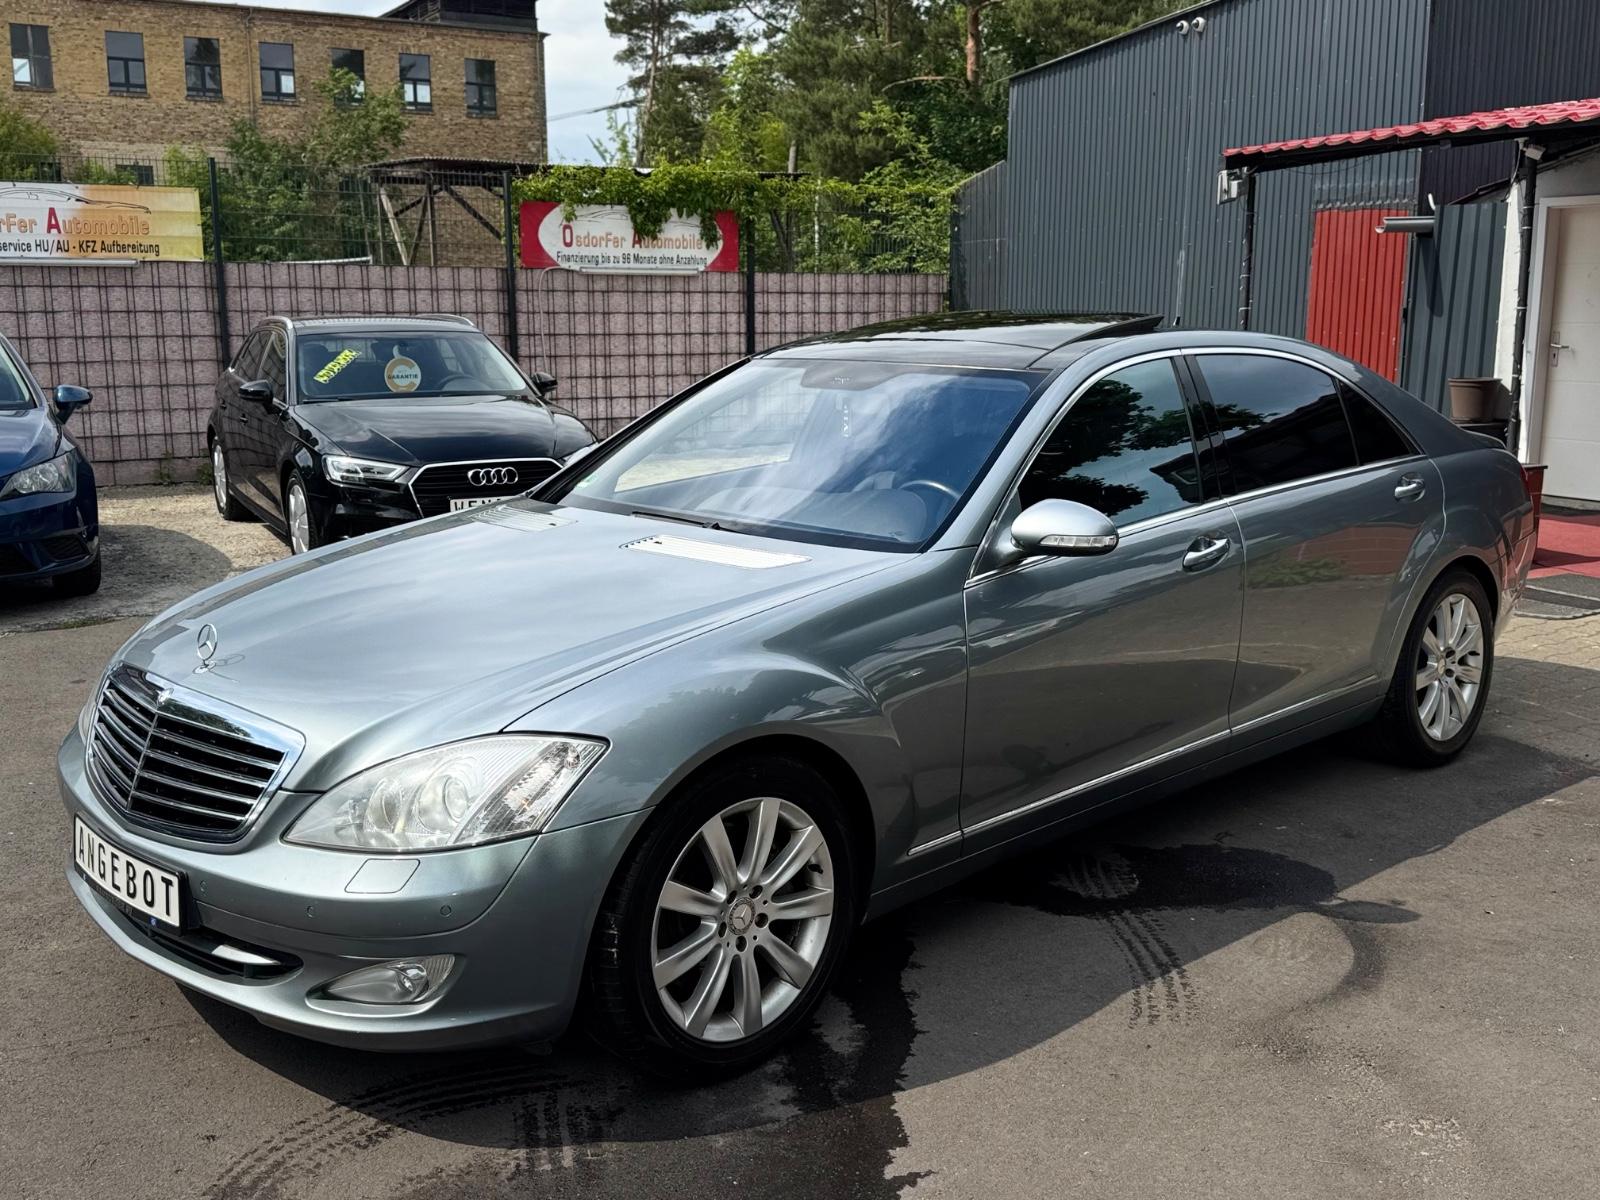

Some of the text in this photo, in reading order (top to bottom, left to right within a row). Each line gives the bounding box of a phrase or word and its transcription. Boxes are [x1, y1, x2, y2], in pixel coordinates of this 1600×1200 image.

[46, 207, 150, 235] Automobile
[35, 239, 70, 255] HU/AU
[79, 240, 98, 254] KFZ
[100, 240, 160, 257] Aufbereitung
[562, 224, 626, 249] OsdorFer
[556, 251, 708, 267] Finanzierung bis zu 96 Monate ohne Anzahlung
[79, 826, 174, 917] ANGEBOT
